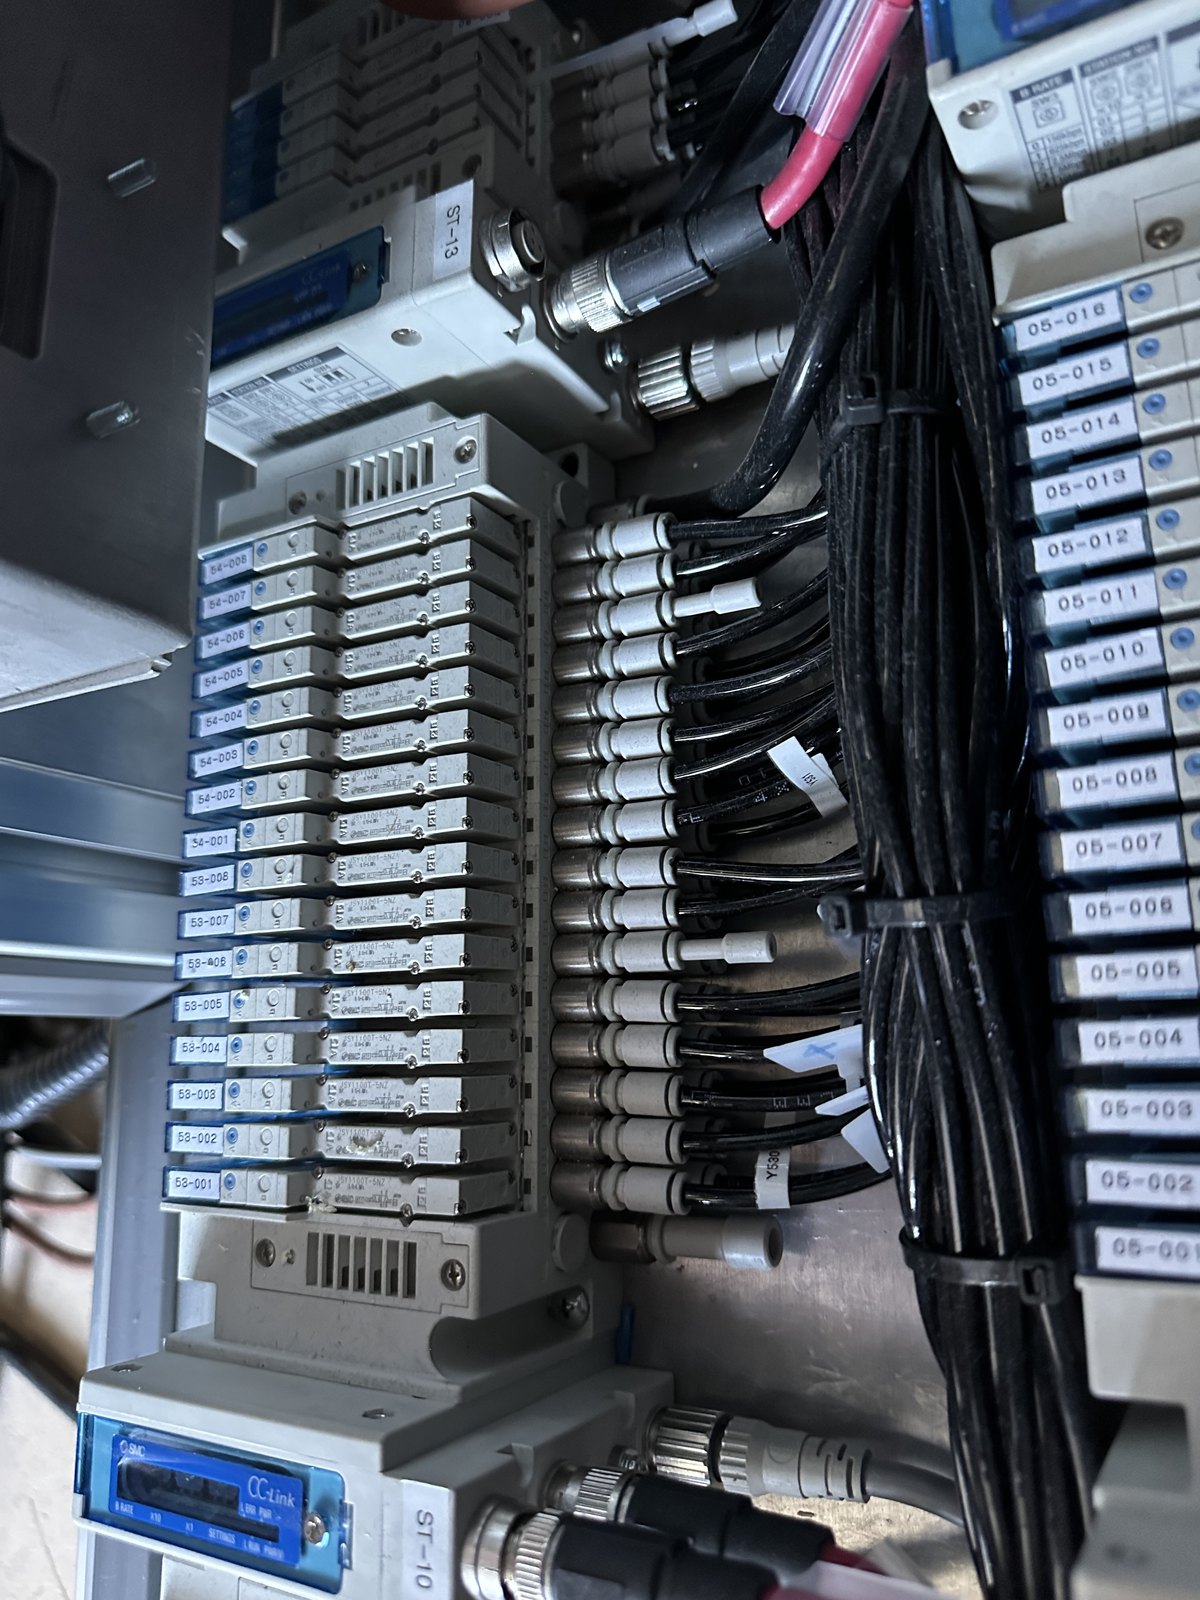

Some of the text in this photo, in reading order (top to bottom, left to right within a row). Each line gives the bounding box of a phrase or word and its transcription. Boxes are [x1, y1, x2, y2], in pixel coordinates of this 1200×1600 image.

[444, 204, 461, 260] ST-13
[1028, 302, 1106, 337] 05-016
[1032, 357, 1113, 391] 05-015
[1041, 411, 1121, 444] 05-014
[1046, 468, 1127, 500] 05-013
[1048, 528, 1130, 558] 05-012
[210, 554, 247, 575] 54-008
[208, 590, 246, 609] 54-007
[1058, 584, 1138, 612] 05-011
[207, 629, 245, 648] 54-006
[1060, 640, 1145, 673] 05-010
[205, 667, 243, 687] 54-005
[206, 710, 243, 727] 54-004
[1063, 702, 1150, 731] 05-009
[200, 749, 238, 768] 54-003
[1072, 766, 1158, 793] 05-008
[198, 788, 236, 804] 54-002
[192, 835, 228, 848] 54-001
[1076, 832, 1163, 858] 05-007
[191, 871, 229, 886] 53-008
[1085, 896, 1174, 920] 05-006
[191, 915, 229, 927] 53-007
[1091, 959, 1180, 982] 05-005
[184, 999, 223, 1011] 53-005
[182, 1042, 220, 1053] 53-004
[1094, 1027, 1184, 1049] 05-004
[178, 1089, 216, 1100] 53-003
[1101, 1099, 1194, 1119] 05-003
[178, 1131, 217, 1144] 53-002
[766, 1150, 780, 1180] Y530
[175, 1177, 212, 1190] 53-001
[1101, 1169, 1193, 1193] 05-002
[129, 1442, 146, 1457] SMC
[248, 1475, 296, 1508] CC-Link
[120, 1503, 134, 1515] RATE
[208, 1527, 236, 1544] SETTINGS
[416, 1509, 434, 1589] ST-10
